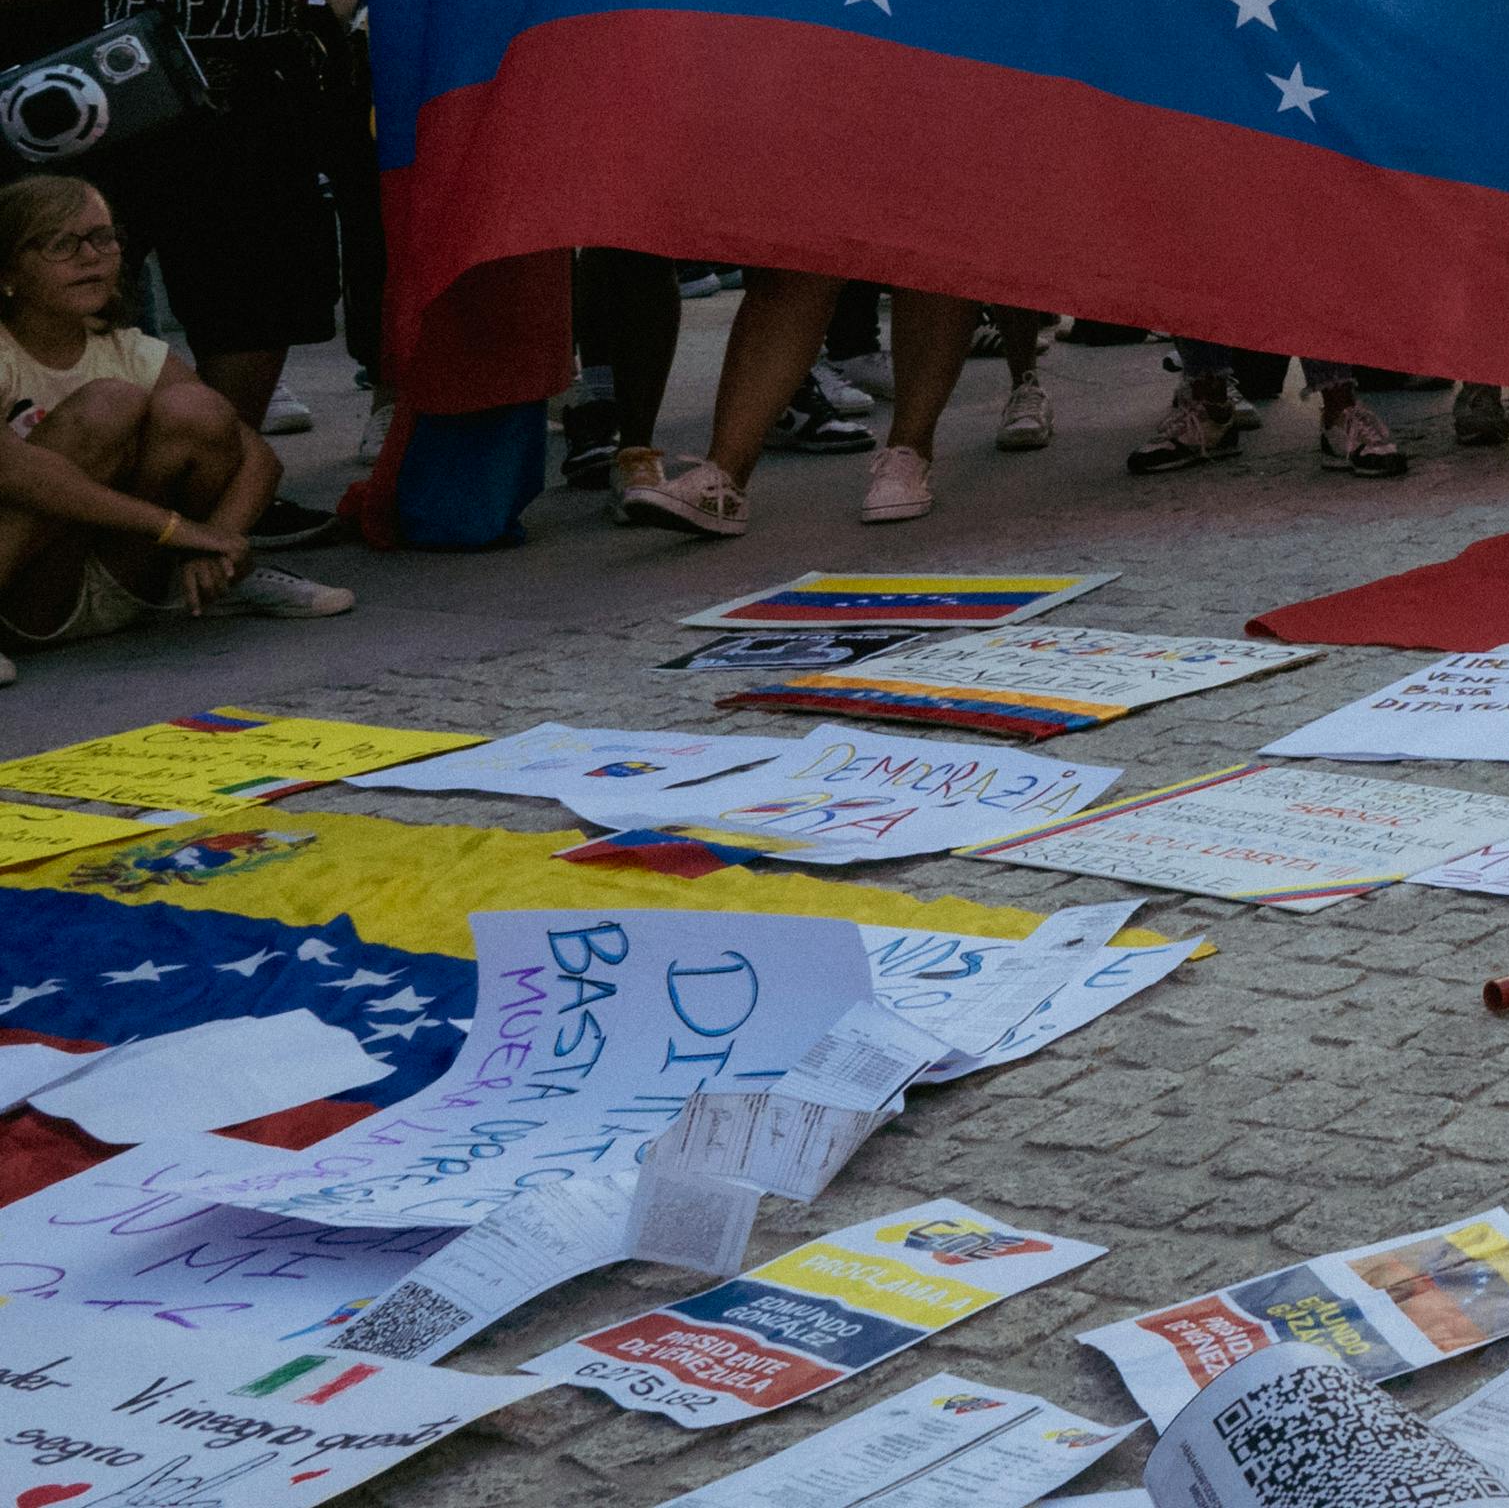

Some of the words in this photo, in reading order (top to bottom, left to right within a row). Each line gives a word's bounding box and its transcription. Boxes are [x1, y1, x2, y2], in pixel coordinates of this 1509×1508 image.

[422, 965, 547, 1112] MUERA
[508, 920, 629, 1105] BASTA
[800, 1254, 944, 1307] PROCLAMA
[948, 1295, 974, 1314] A
[751, 1295, 863, 1339] EDMUNDO
[617, 1338, 649, 1359] DE
[648, 1346, 774, 1396] VENEZUELA
[656, 1329, 792, 1376] PRESIDENTE
[4, 1428, 145, 1467] segno
[157, 1399, 316, 1450] insegno
